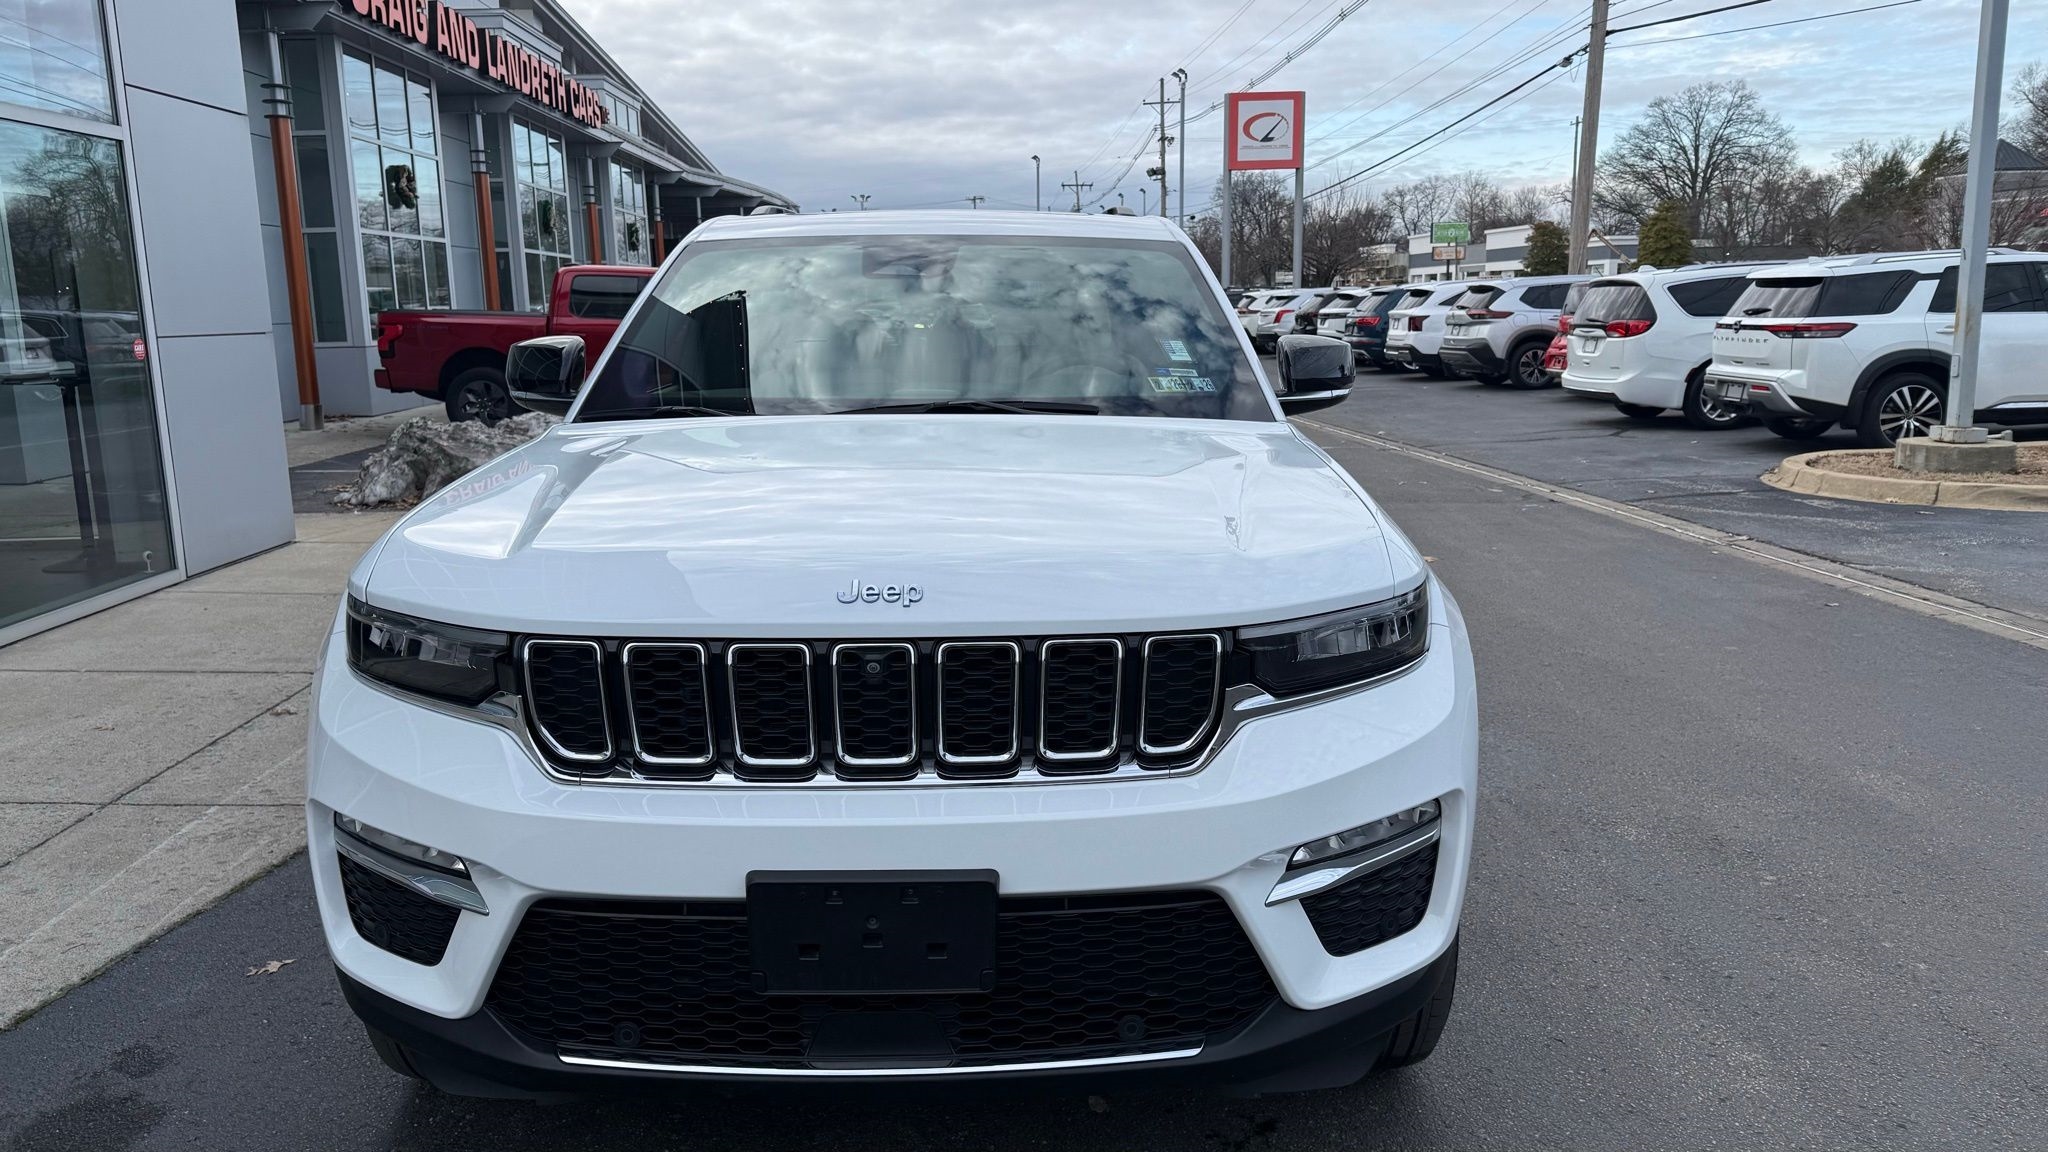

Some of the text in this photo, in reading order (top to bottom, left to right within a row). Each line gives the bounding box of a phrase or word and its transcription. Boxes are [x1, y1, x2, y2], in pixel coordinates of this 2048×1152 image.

[352, 0, 602, 129] AIG AND LANDRETH CARS
[836, 579, 924, 608] Jeep
